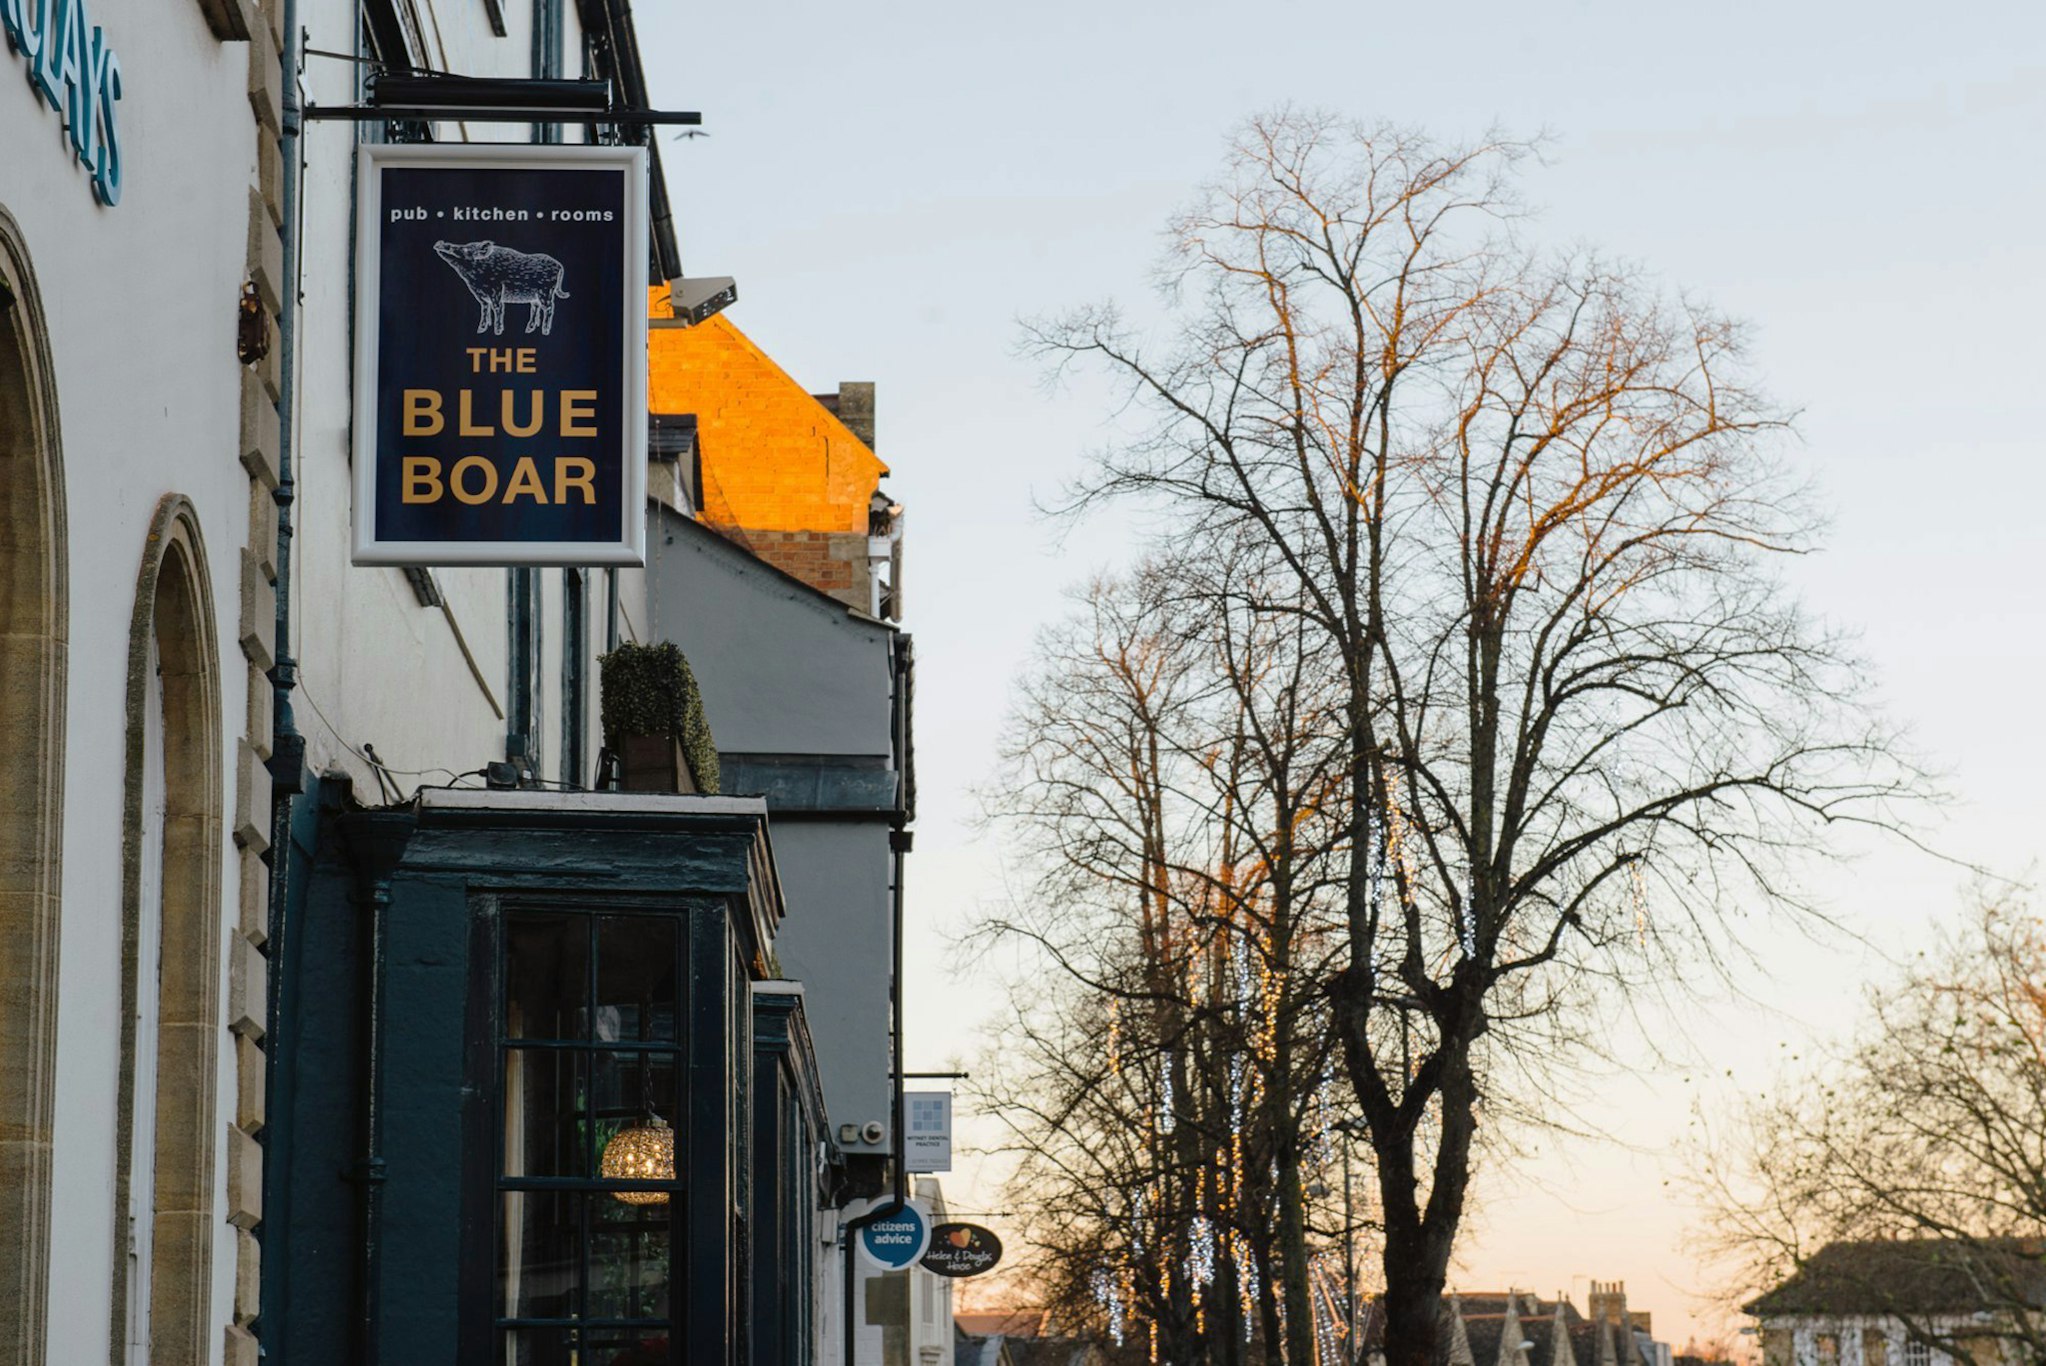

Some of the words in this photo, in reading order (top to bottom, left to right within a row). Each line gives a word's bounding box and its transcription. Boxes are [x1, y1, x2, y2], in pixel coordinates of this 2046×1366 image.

[0, 0, 121, 206] LAYS
[390, 206, 428, 223] pub
[453, 206, 529, 221] kitchen
[551, 208, 614, 222] rooms
[466, 347, 537, 373] THE
[402, 389, 598, 437] BLUE
[401, 455, 597, 505] BOAR
[871, 1220, 916, 1232] citizens
[874, 1232, 912, 1244] advice
[926, 1250, 952, 1261] Helen
[954, 1250, 960, 1262] &
